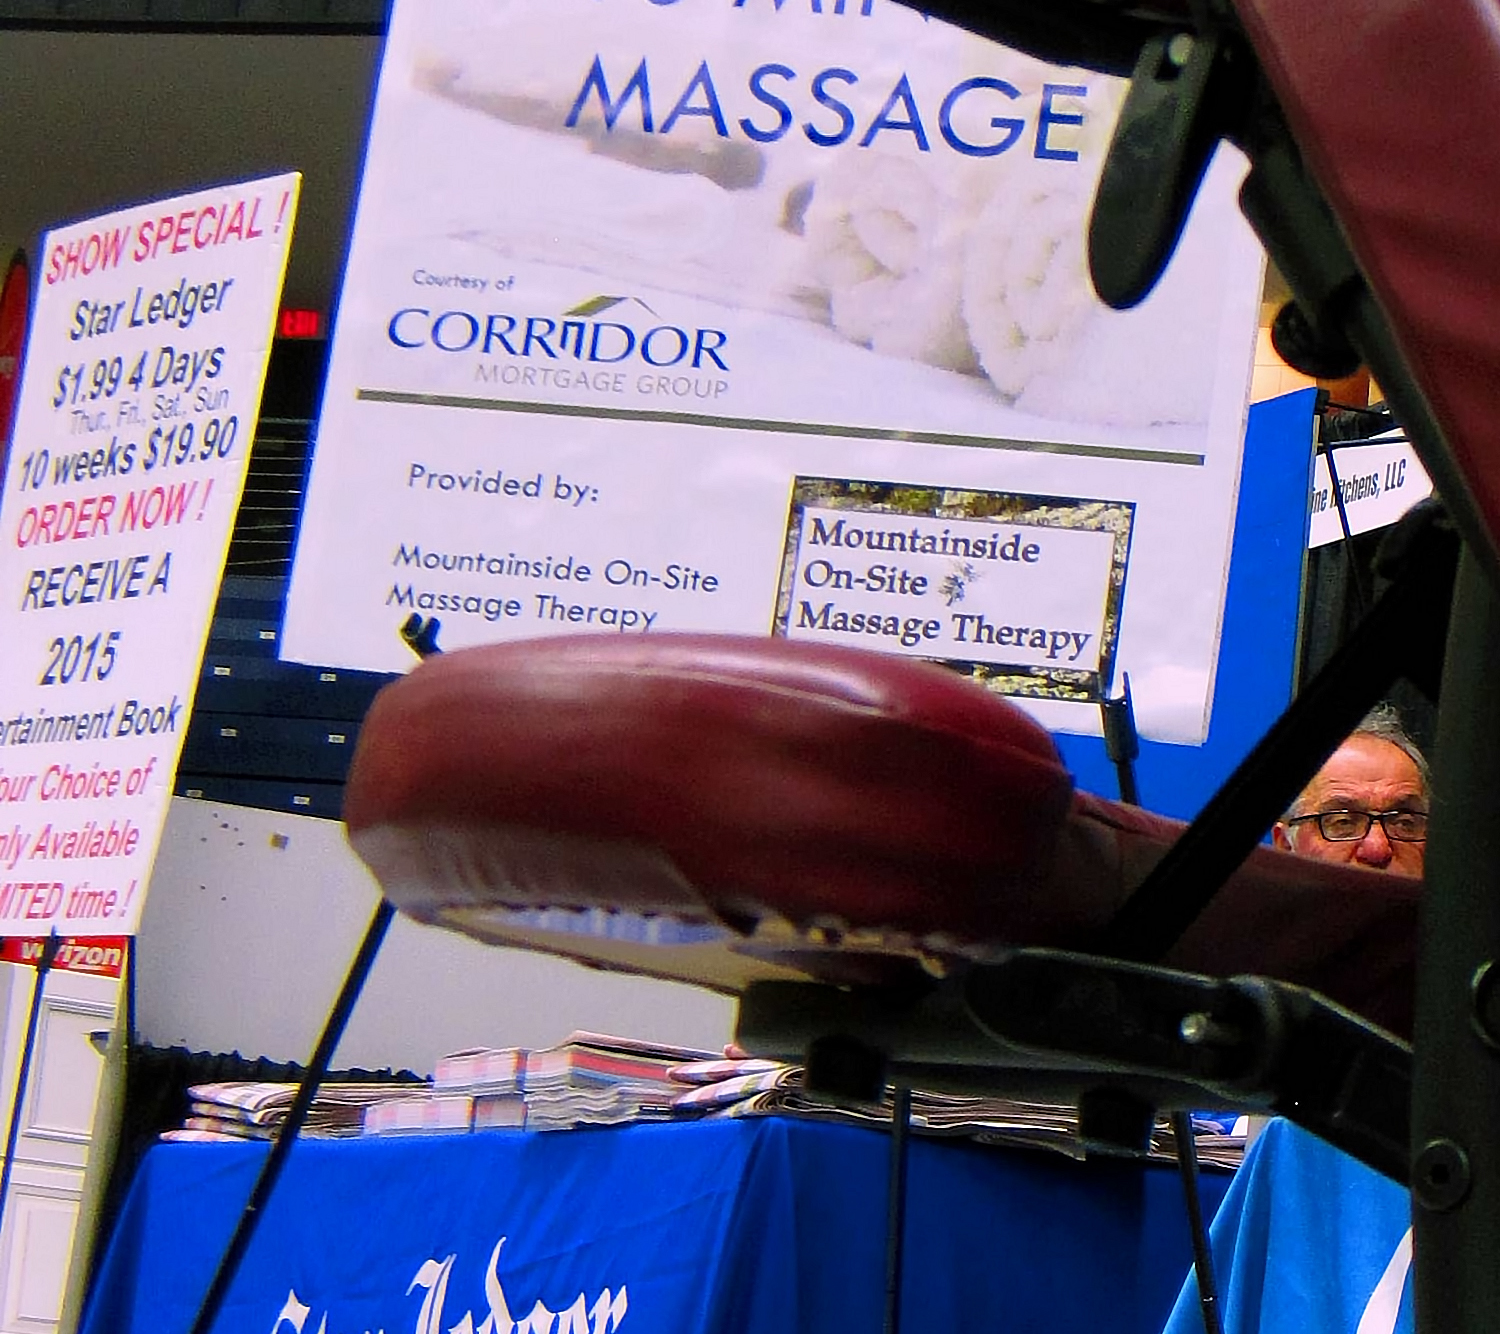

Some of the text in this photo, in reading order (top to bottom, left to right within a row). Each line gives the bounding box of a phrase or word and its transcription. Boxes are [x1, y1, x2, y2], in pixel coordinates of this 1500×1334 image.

[564, 53, 1088, 162] MASSAGE
[47, 226, 130, 285] SHOW
[134, 197, 263, 263] SPECIAL
[413, 268, 515, 293] Courtesy of
[70, 278, 234, 341] Star Ledger
[387, 307, 730, 371] CORRIDOR
[53, 346, 226, 408] $1.99 4 Days
[194, 386, 229, 413] Sun
[475, 364, 729, 400] MORTGAGE GROUP
[20, 415, 238, 491] 10 weeks $19.90
[1384, 458, 1406, 492] LLC
[408, 463, 599, 507] Provided by:
[16, 495, 117, 548] ORDER
[119, 480, 199, 534] NOW
[809, 517, 1040, 563] Mountainside
[21, 552, 172, 611] RECEIVE A
[392, 543, 720, 593] Mountainside On-Site
[803, 560, 928, 596] On-Site
[385, 583, 658, 634] Massage Therapy
[796, 601, 1092, 661] Massage Therapy
[40, 631, 121, 686] 2015
[115, 695, 181, 738] Book
[40, 762, 121, 801] Choice
[125, 756, 157, 796] of
[28, 820, 139, 860] Available
[65, 882, 118, 918] time
